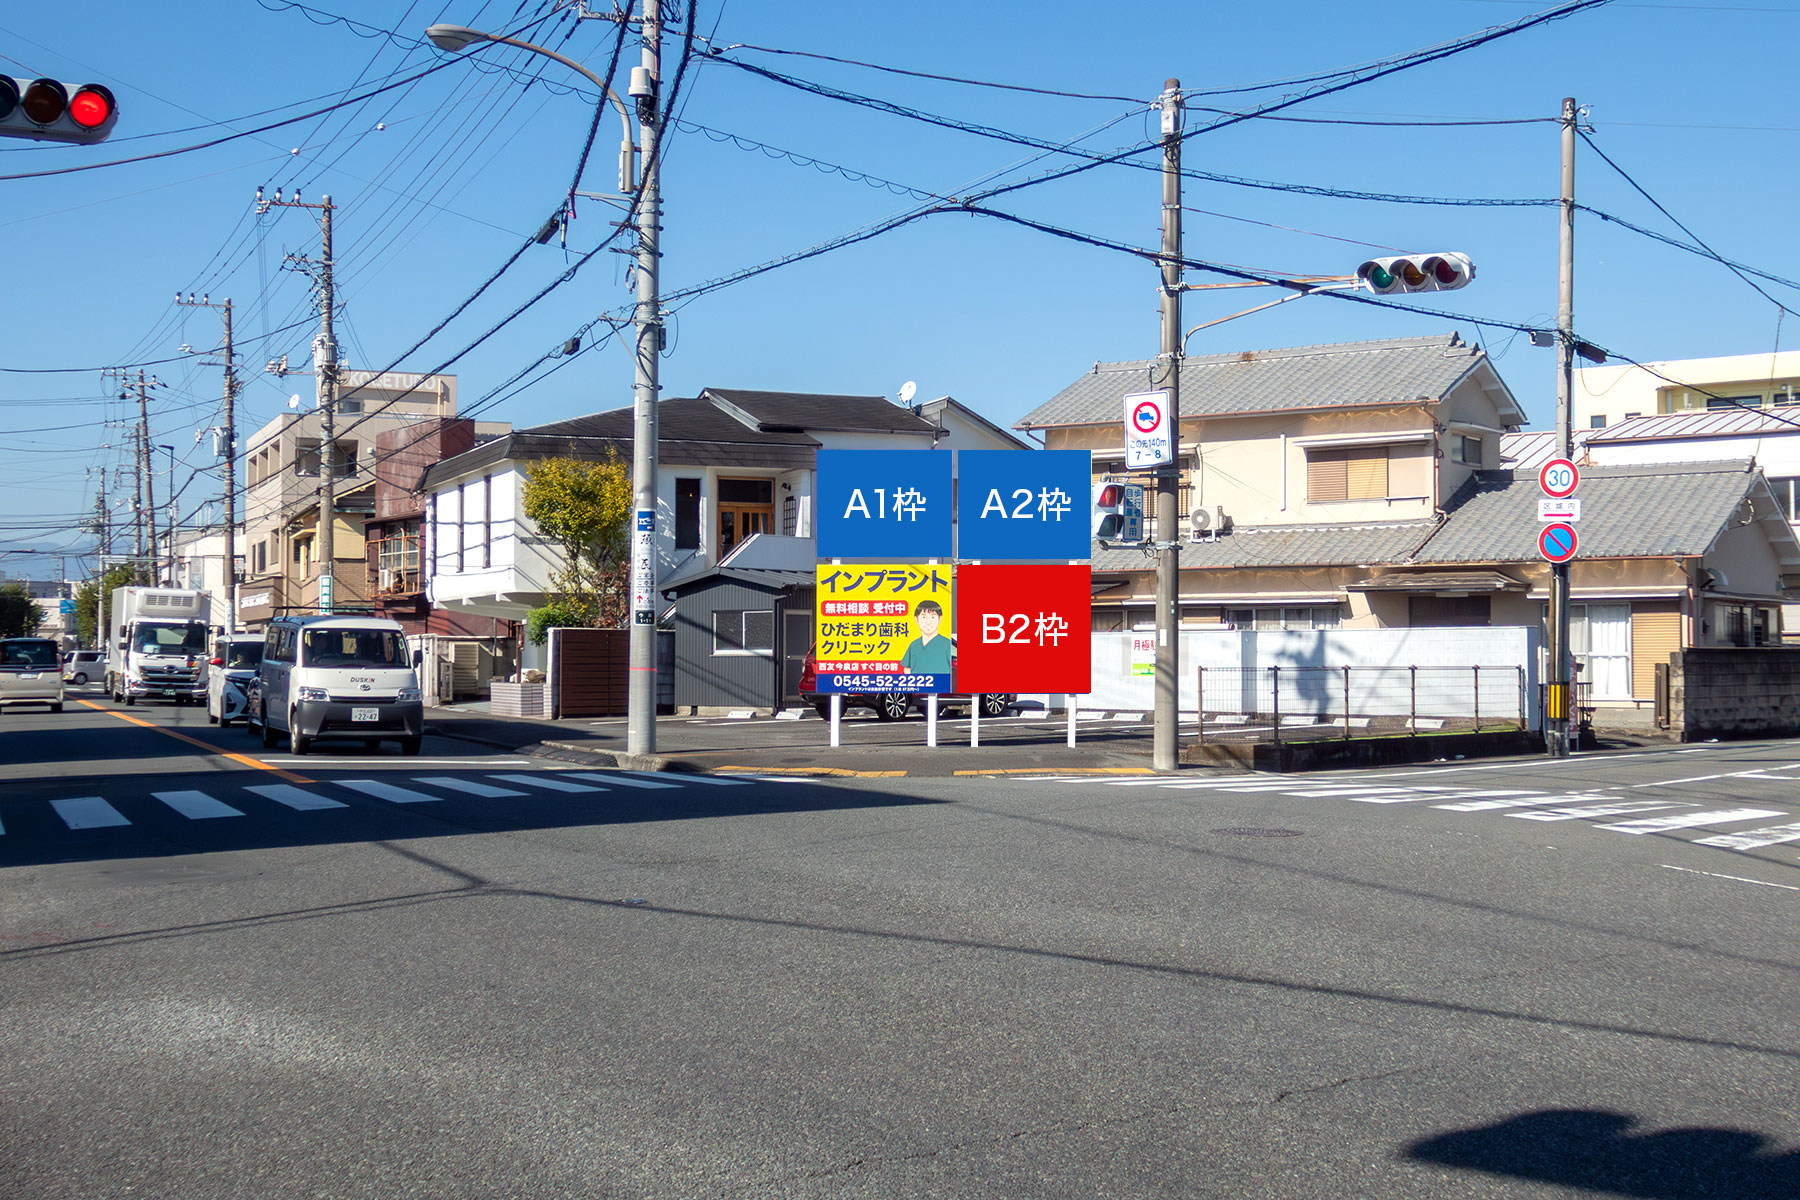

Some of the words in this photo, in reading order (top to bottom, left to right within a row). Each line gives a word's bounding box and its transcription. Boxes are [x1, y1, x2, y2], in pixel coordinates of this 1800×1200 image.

[1549, 470, 1570, 486] 30
[843, 487, 927, 522] A1枠
[980, 487, 1072, 522] A2枠
[820, 569, 948, 593] インプラント
[825, 602, 870, 614] 無料相談
[872, 602, 906, 614] 受付中
[820, 621, 910, 638] ひだまり歯科
[981, 611, 1069, 647] B2枠
[820, 640, 891, 655] クリニック
[833, 675, 934, 687] 0545-52-2222
